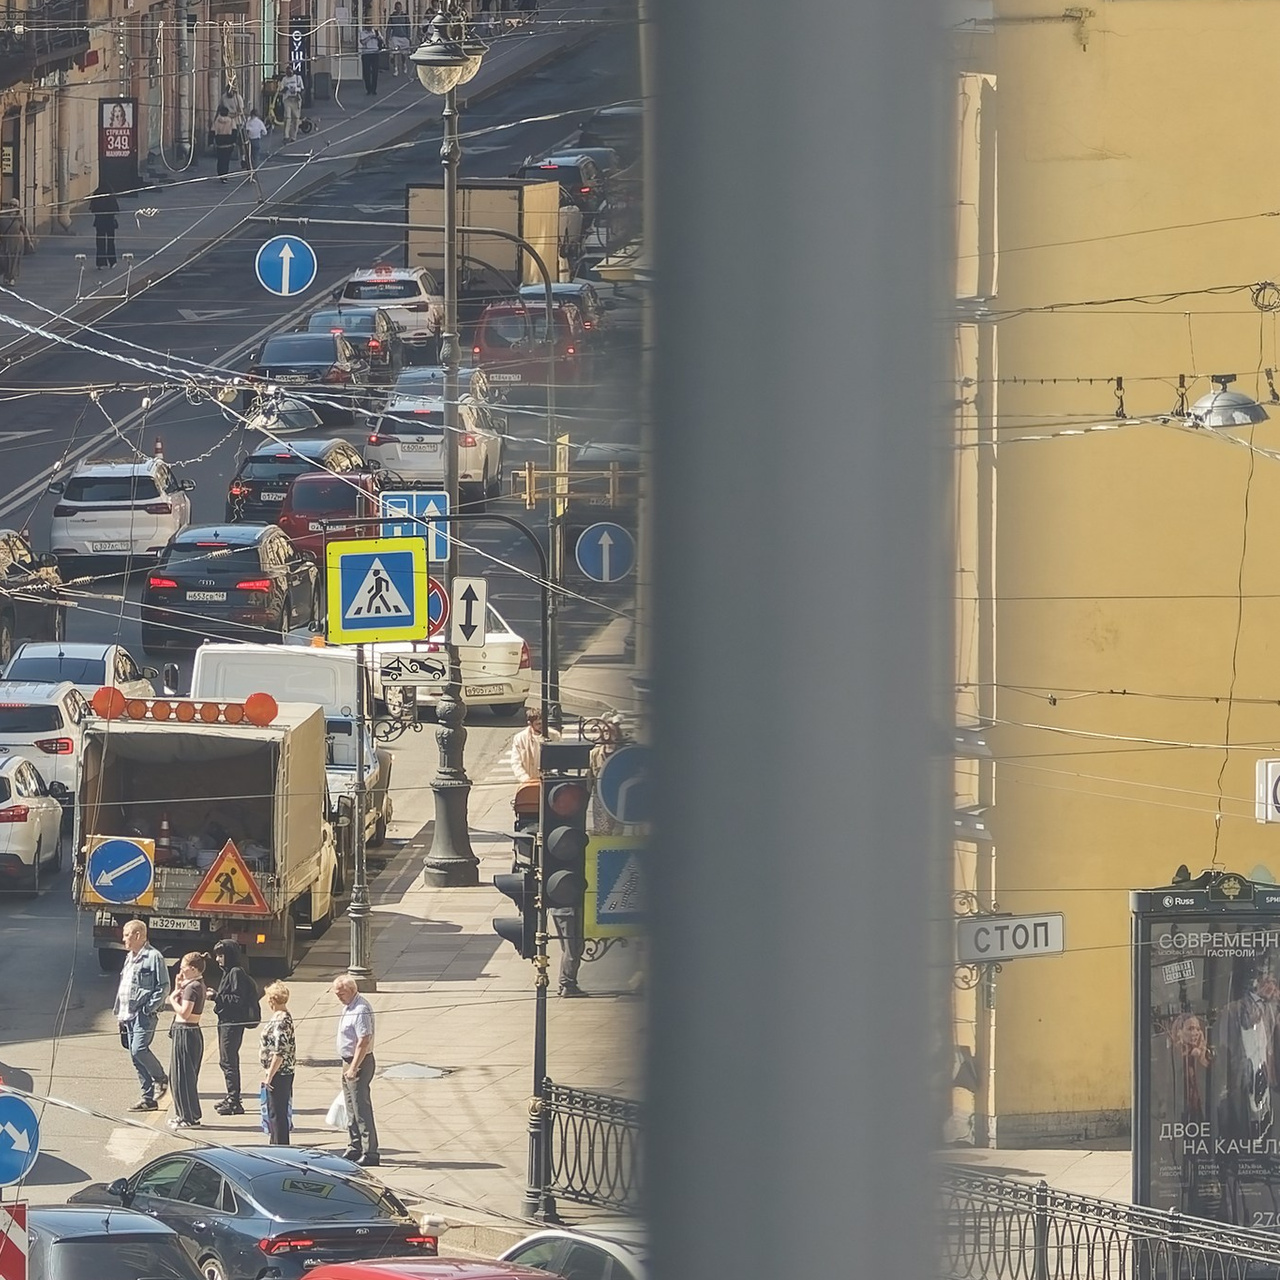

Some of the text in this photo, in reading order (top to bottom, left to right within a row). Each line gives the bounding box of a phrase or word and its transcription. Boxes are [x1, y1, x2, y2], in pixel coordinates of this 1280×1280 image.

[291, 30, 303, 72] СУШИ
[1174, 897, 1195, 906] Russ
[974, 922, 1049, 954] СТОП
[1207, 948, 1256, 957] ГАСТРОЛИ
[1159, 1122, 1211, 1141] ДВОЕ
[1183, 1138, 1280, 1155] НА КАЧЕЛ
